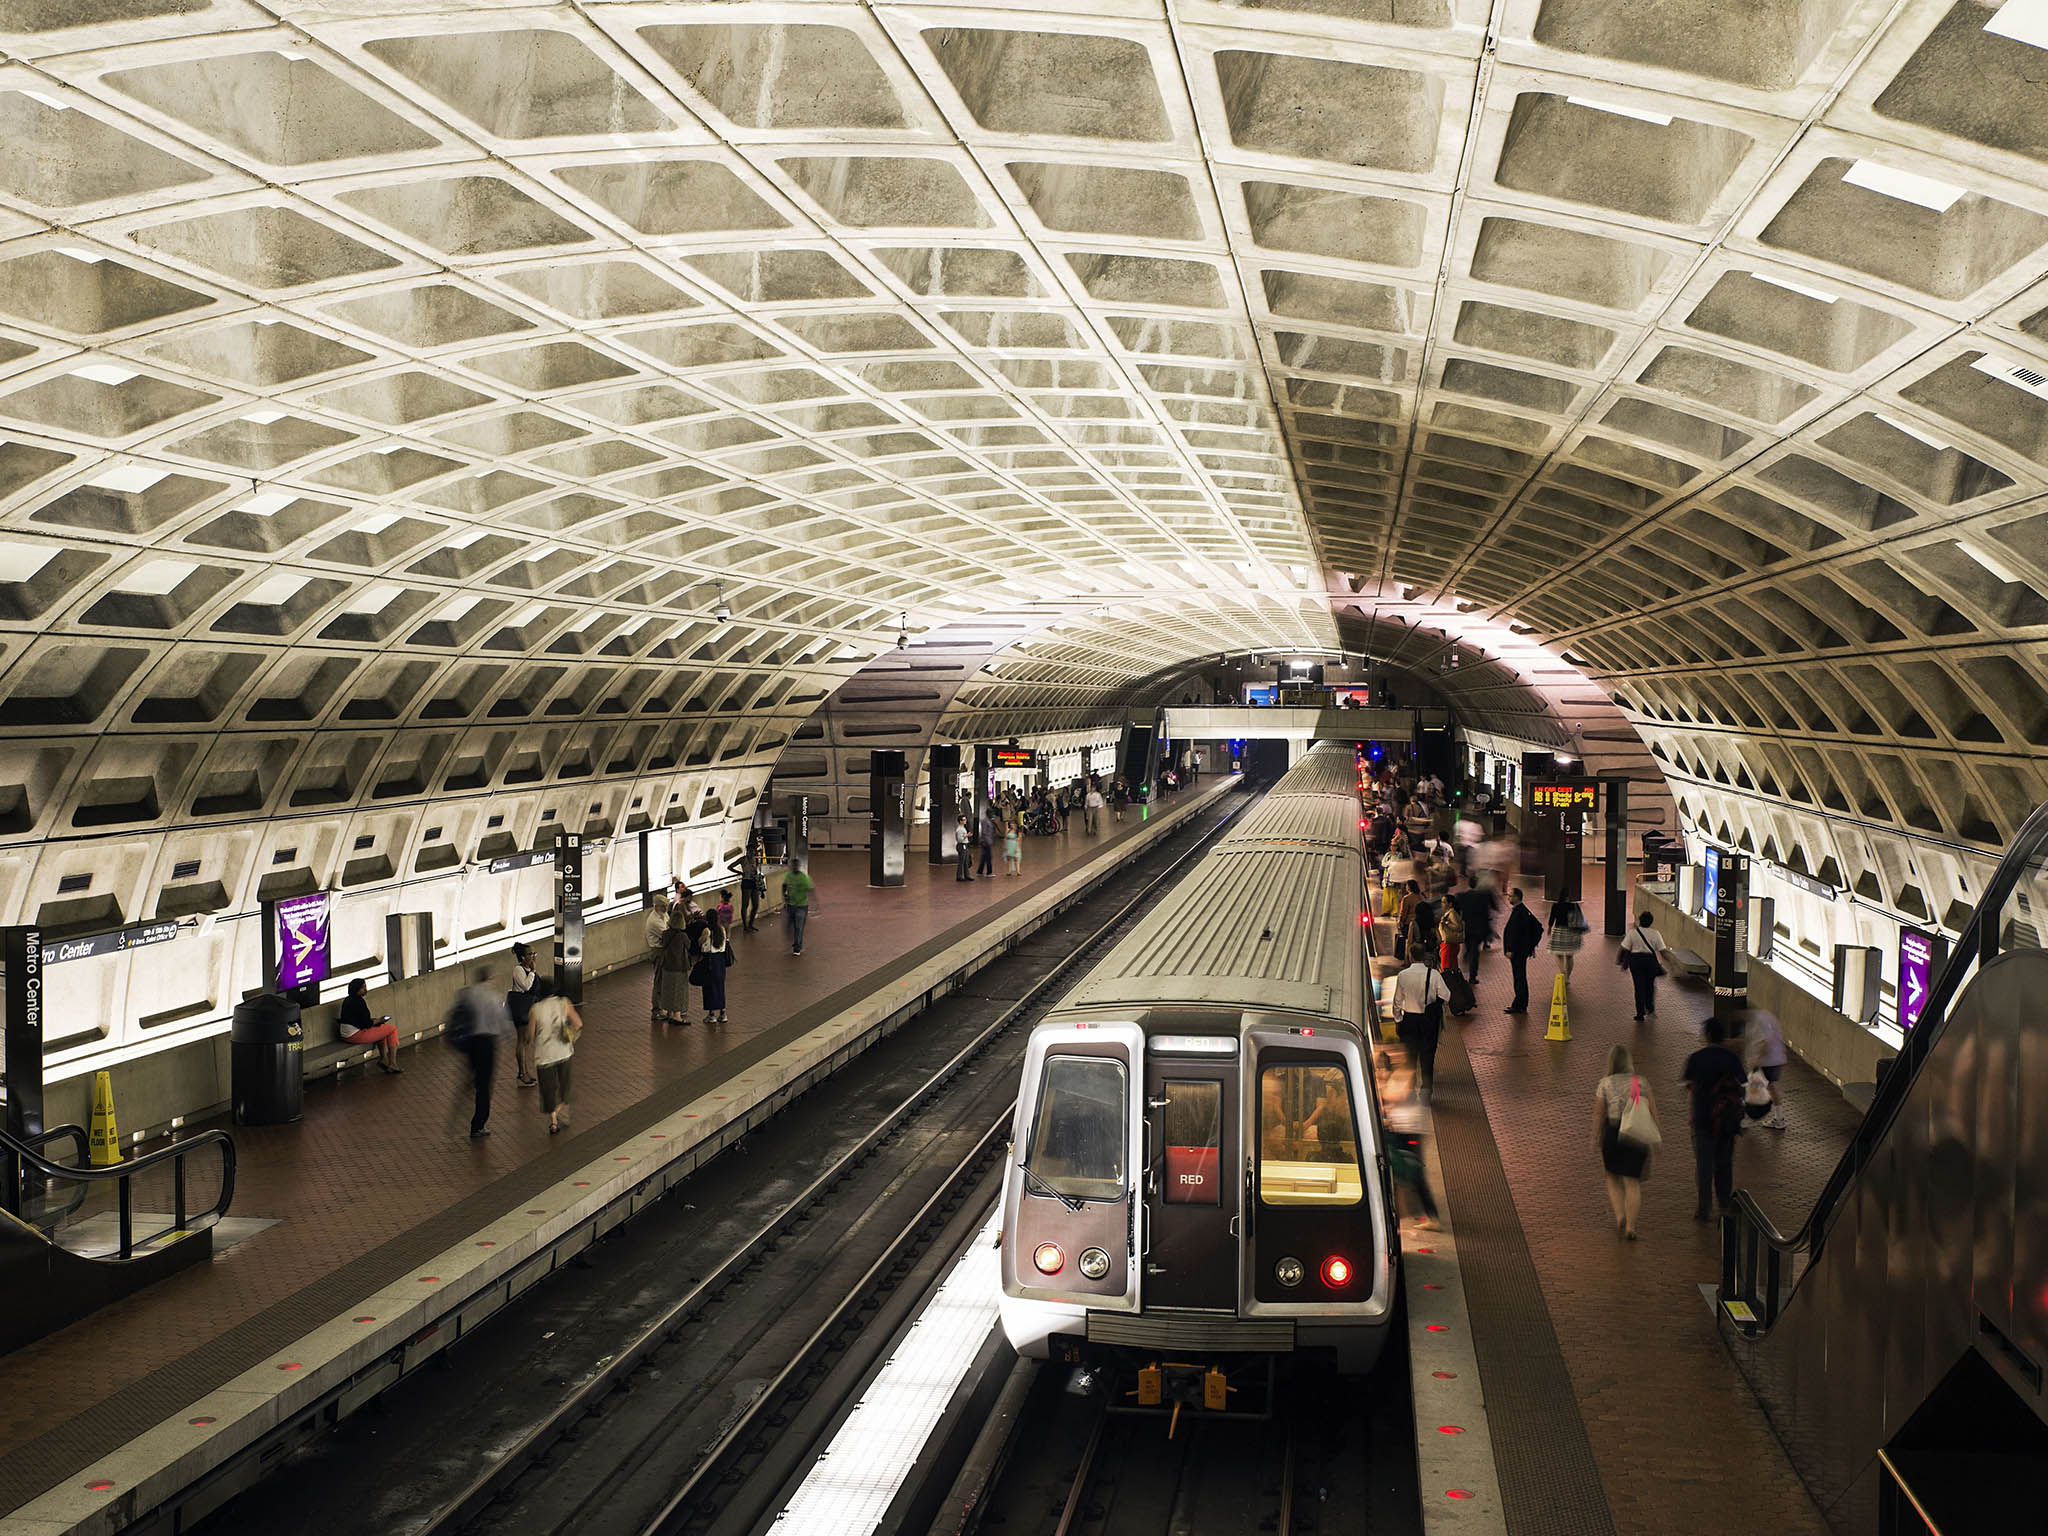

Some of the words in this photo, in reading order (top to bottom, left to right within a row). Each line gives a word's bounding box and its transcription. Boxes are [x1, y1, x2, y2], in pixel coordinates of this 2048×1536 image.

[26, 932, 40, 974] Metro
[42, 949, 56, 964] tro
[59, 942, 95, 961] Center
[26, 978, 41, 1026] Center
[91, 1138, 105, 1146] FLOOR
[1180, 1174, 1204, 1185] RED
